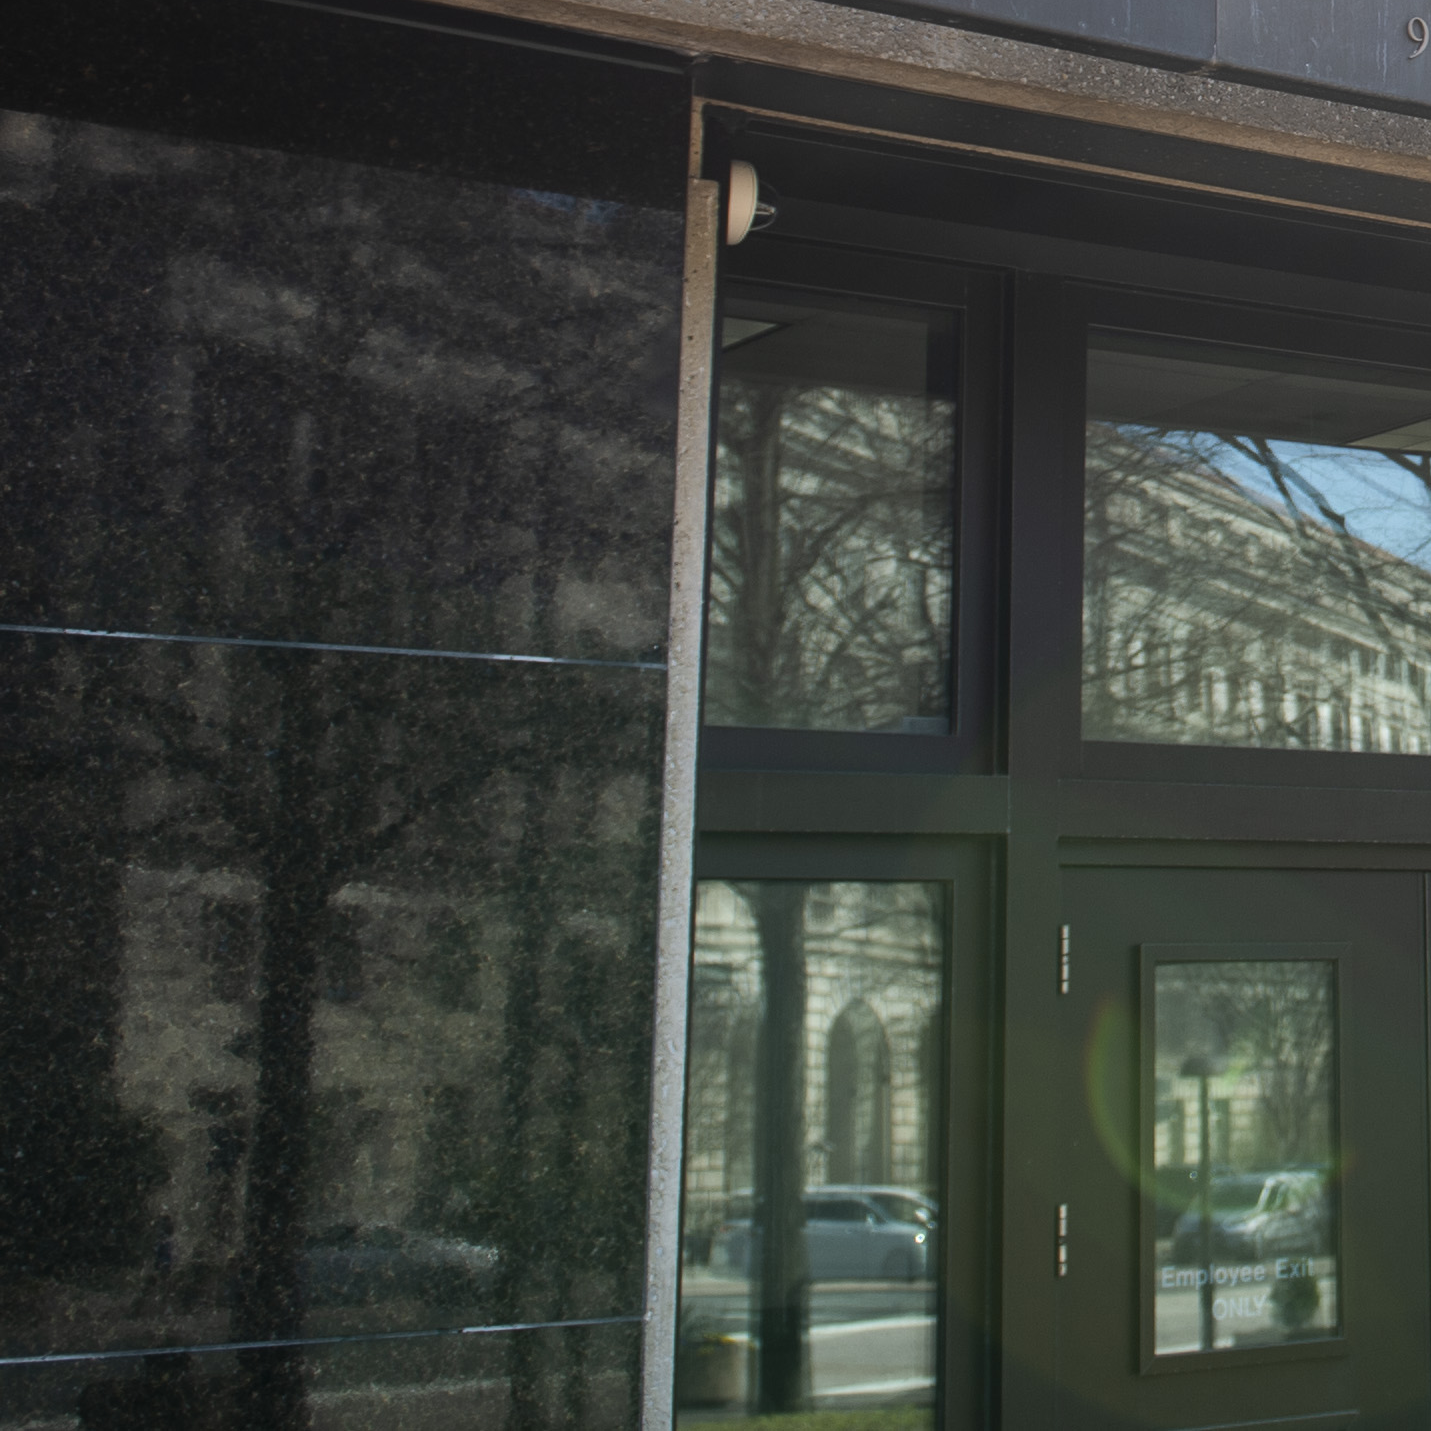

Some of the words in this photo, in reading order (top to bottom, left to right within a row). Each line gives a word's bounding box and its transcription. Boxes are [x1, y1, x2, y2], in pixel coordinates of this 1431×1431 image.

[1160, 1261, 1267, 1290] Employee
[1274, 1256, 1316, 1280] Exit
[1211, 1293, 1268, 1321] ONLY
